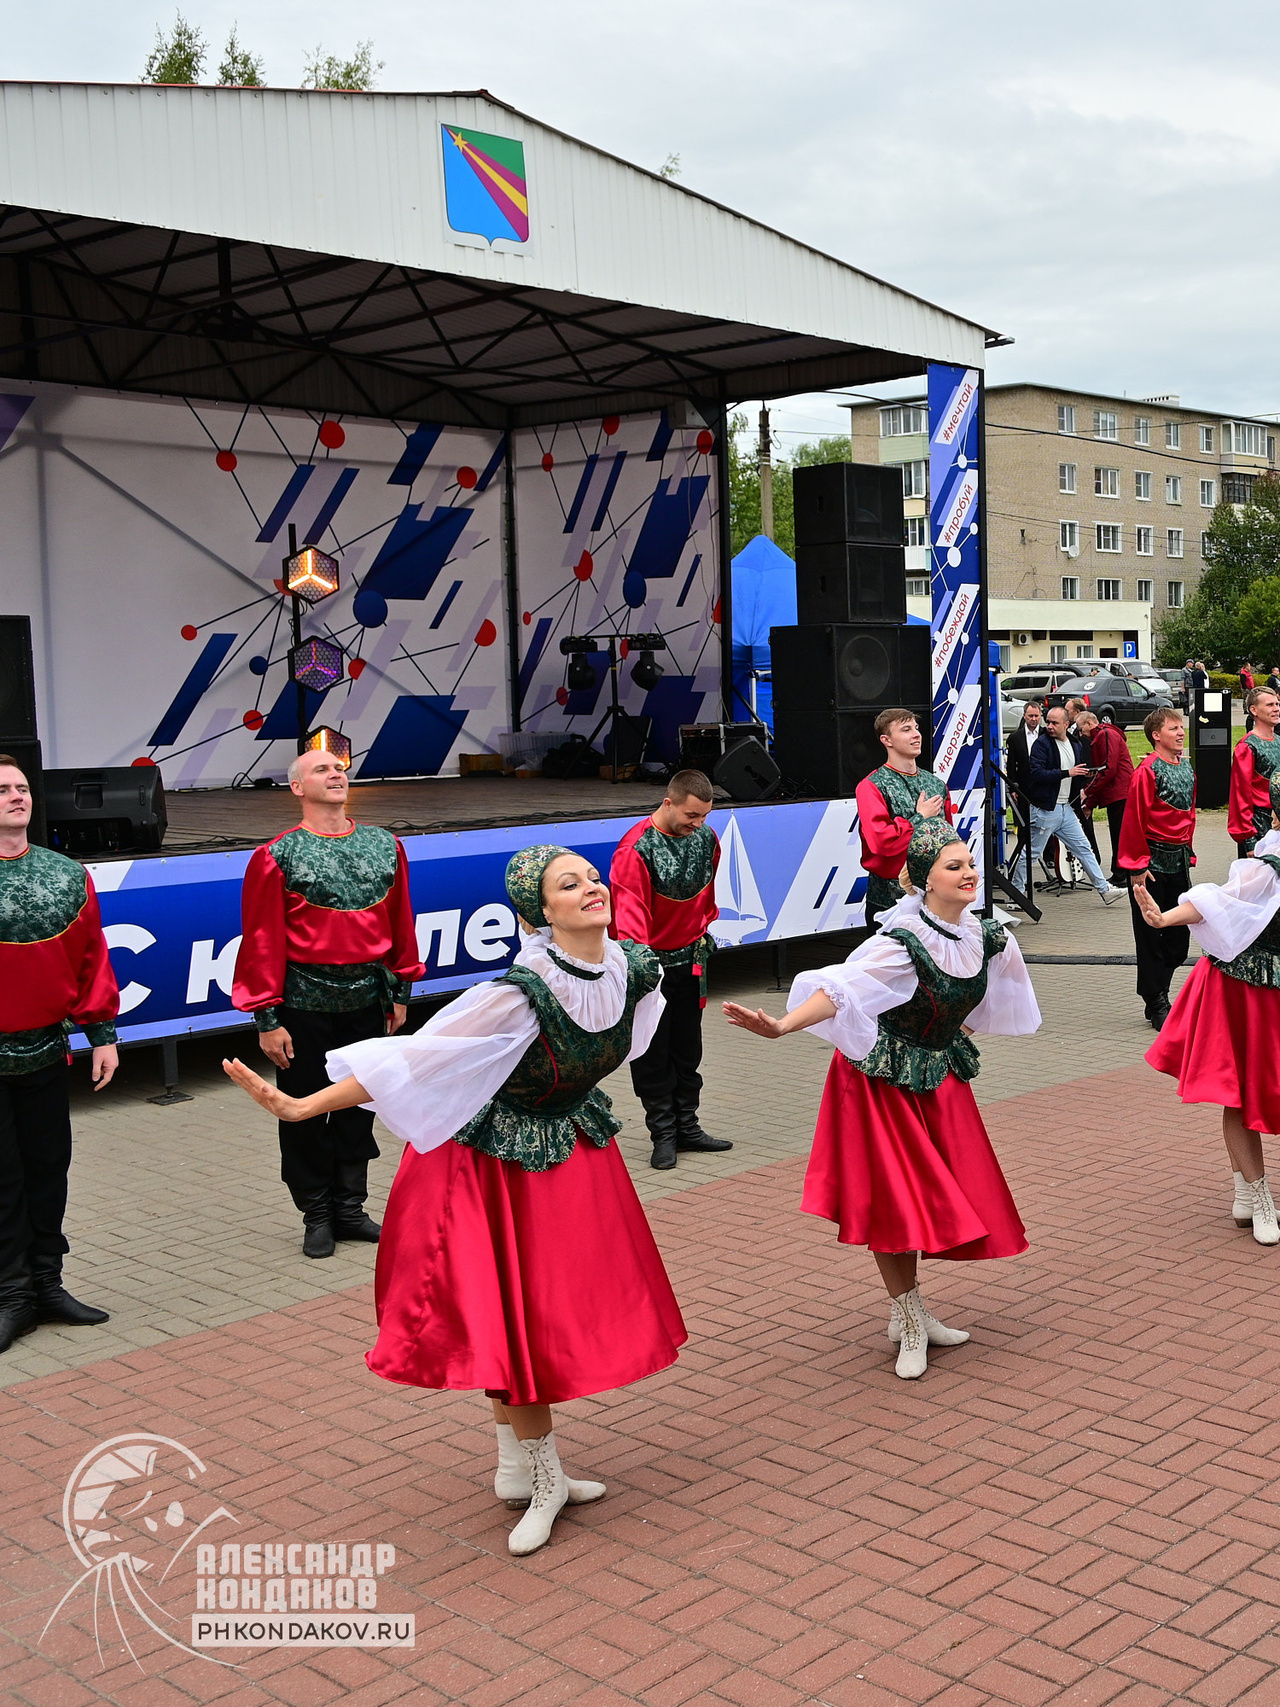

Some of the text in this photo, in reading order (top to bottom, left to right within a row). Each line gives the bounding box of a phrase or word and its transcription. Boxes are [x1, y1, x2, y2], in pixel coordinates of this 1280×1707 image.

[943, 383, 973, 441] #мечтай
[944, 484, 973, 543] #пробуй
[934, 593, 969, 668] #побеждай
[1126, 643, 1133, 657] P
[938, 712, 968, 773] #дерзай
